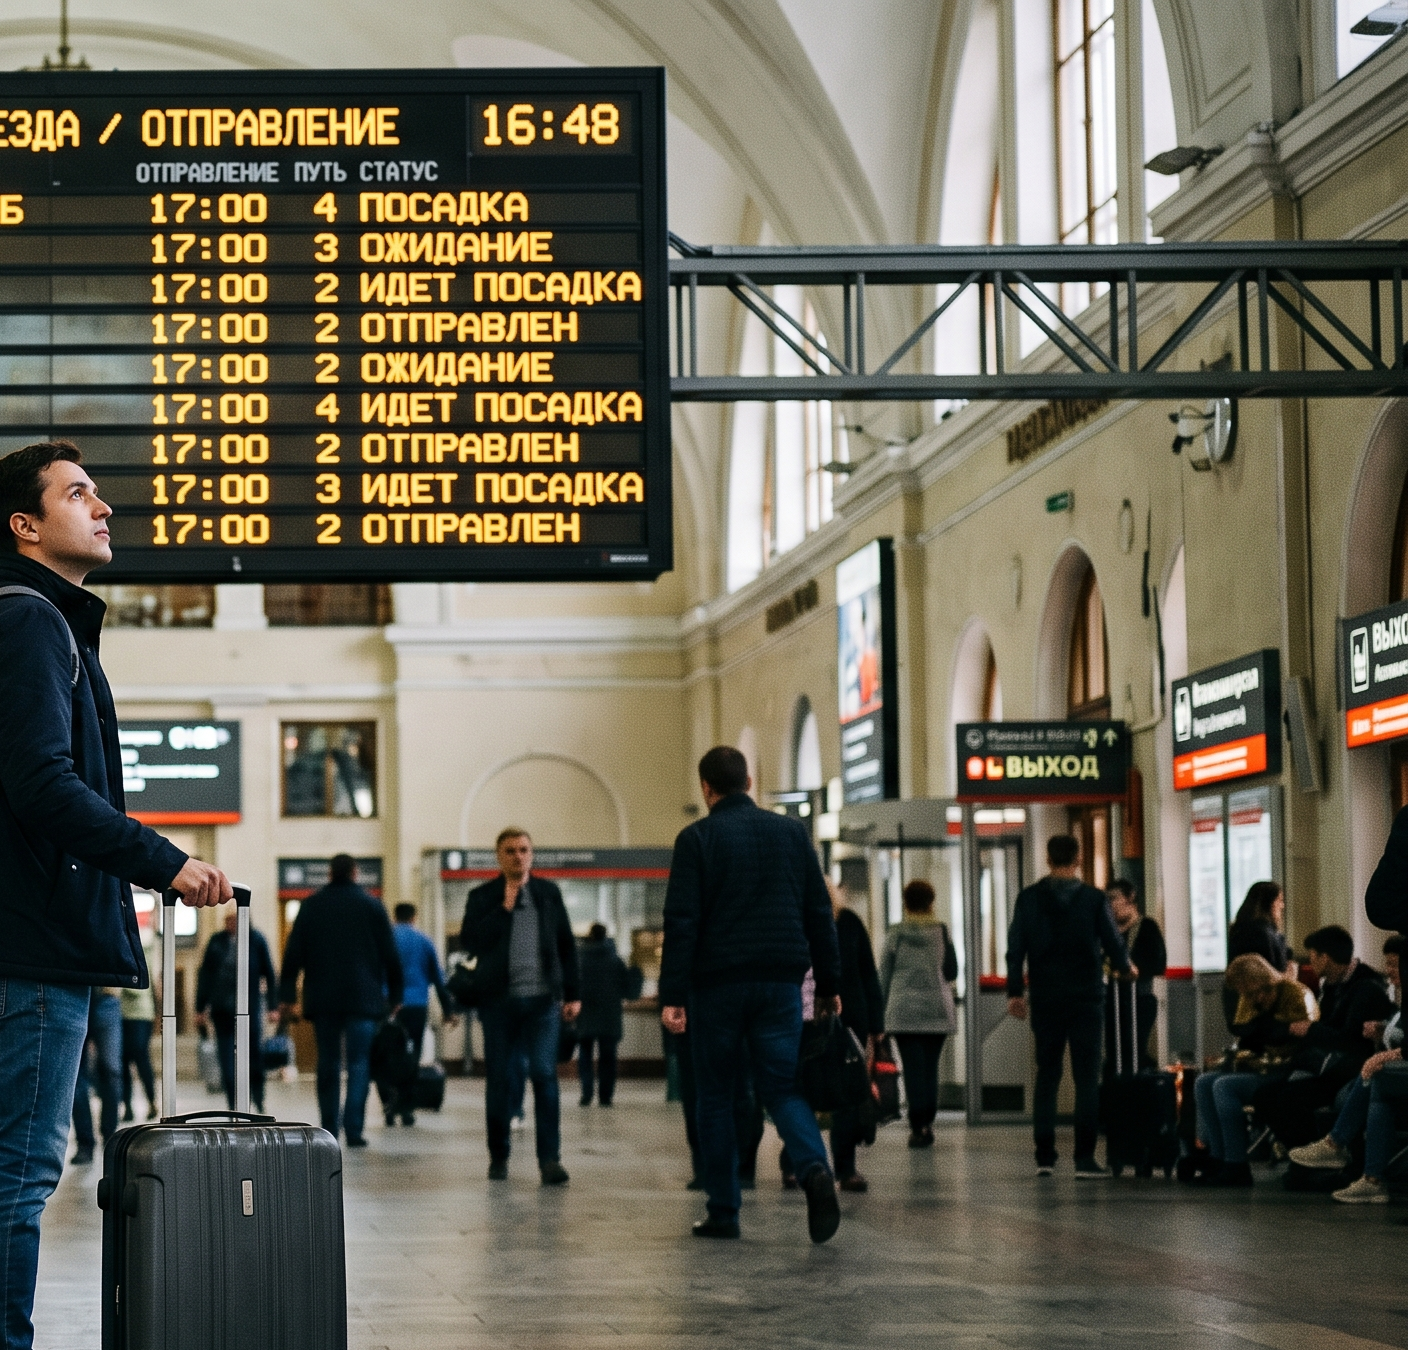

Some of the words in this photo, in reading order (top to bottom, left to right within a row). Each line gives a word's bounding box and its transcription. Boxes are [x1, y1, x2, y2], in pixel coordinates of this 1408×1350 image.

[98, 113, 122, 145] /
[141, 107, 400, 147] ОТПРАВЛЕНИЕ
[482, 103, 620, 146] 16:48
[135, 161, 280, 183] ОТПРАВЛЕНИЕ
[294, 161, 348, 182] ПУТЬ
[359, 160, 439, 182] СТАТУС
[151, 194, 267, 223] 17:00
[314, 193, 337, 222] 4
[360, 192, 528, 226] ПОСАДКА
[152, 234, 267, 263] 17:00
[314, 233, 338, 262] 3
[360, 232, 553, 265] ОЖИДАНИЕ
[152, 274, 268, 303] 17:00
[315, 273, 339, 302] 2
[360, 272, 456, 306] ИДЕТ
[474, 271, 641, 305] ПОСАДКА
[152, 313, 268, 344] 17:00
[315, 313, 339, 343] 2
[361, 312, 578, 342] ОТПРАВЛЕН
[151, 354, 268, 384] 17:00
[315, 353, 339, 383] 2
[361, 352, 554, 386] ОЖИДАНИЕ
[152, 394, 268, 424] 17:00
[316, 393, 340, 423] 4
[361, 393, 457, 427] ИДЕТ
[475, 392, 642, 425] ПОСАДКА
[152, 434, 269, 464] 17:00
[316, 434, 340, 463] 2
[362, 432, 579, 463] ОТПРАВЛЕН
[153, 474, 269, 504] 17:00
[316, 474, 340, 503] 3
[362, 473, 458, 507] ИДЕТ
[476, 472, 643, 506] ПОСАДКА
[153, 514, 269, 544] 17:00
[317, 514, 341, 543] 2
[362, 513, 580, 543] ОТПРАВЛЕН
[1006, 754, 1100, 781] ВЫХОД
